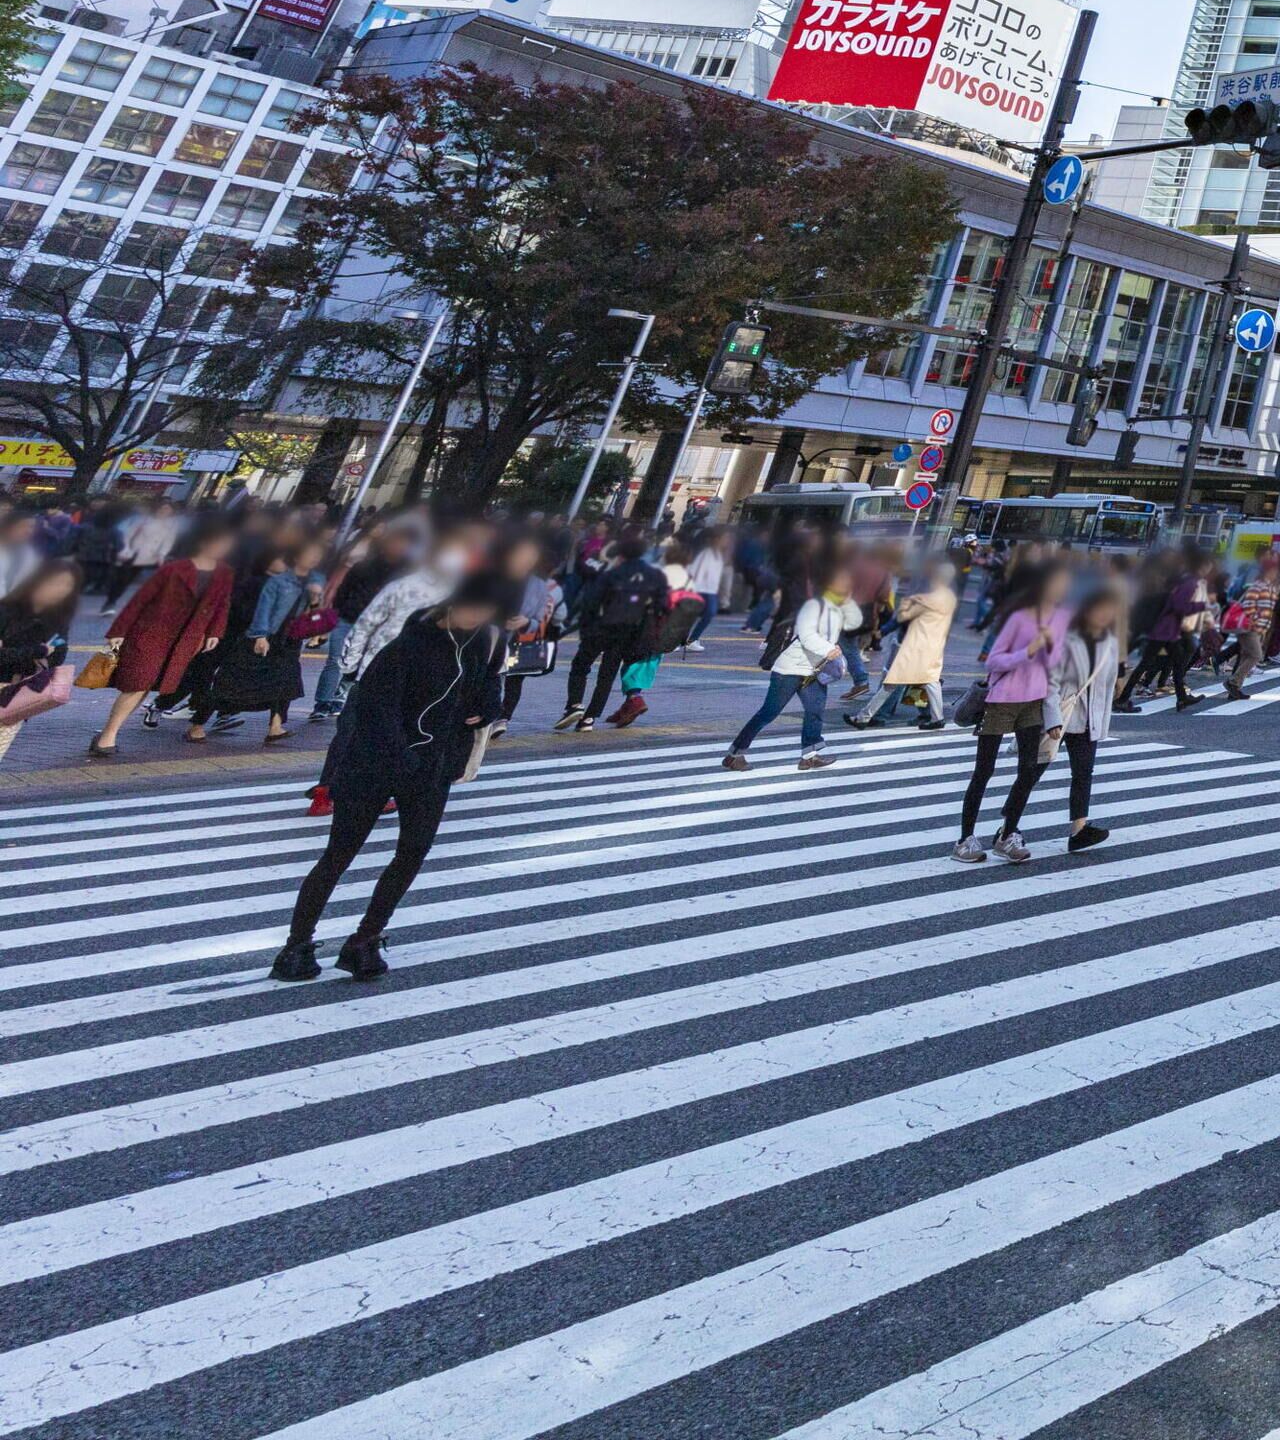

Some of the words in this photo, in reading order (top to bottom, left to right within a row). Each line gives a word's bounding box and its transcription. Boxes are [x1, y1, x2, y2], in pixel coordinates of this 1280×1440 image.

[794, 29, 931, 58] JOYSOUND
[939, 42, 1050, 99] あげていこう。
[946, 16, 1056, 78] ボリューム、
[926, 63, 1045, 123] JOYSOUND
[1098, 478, 1131, 486] SHIBUYA
[1134, 479, 1157, 487] MARK
